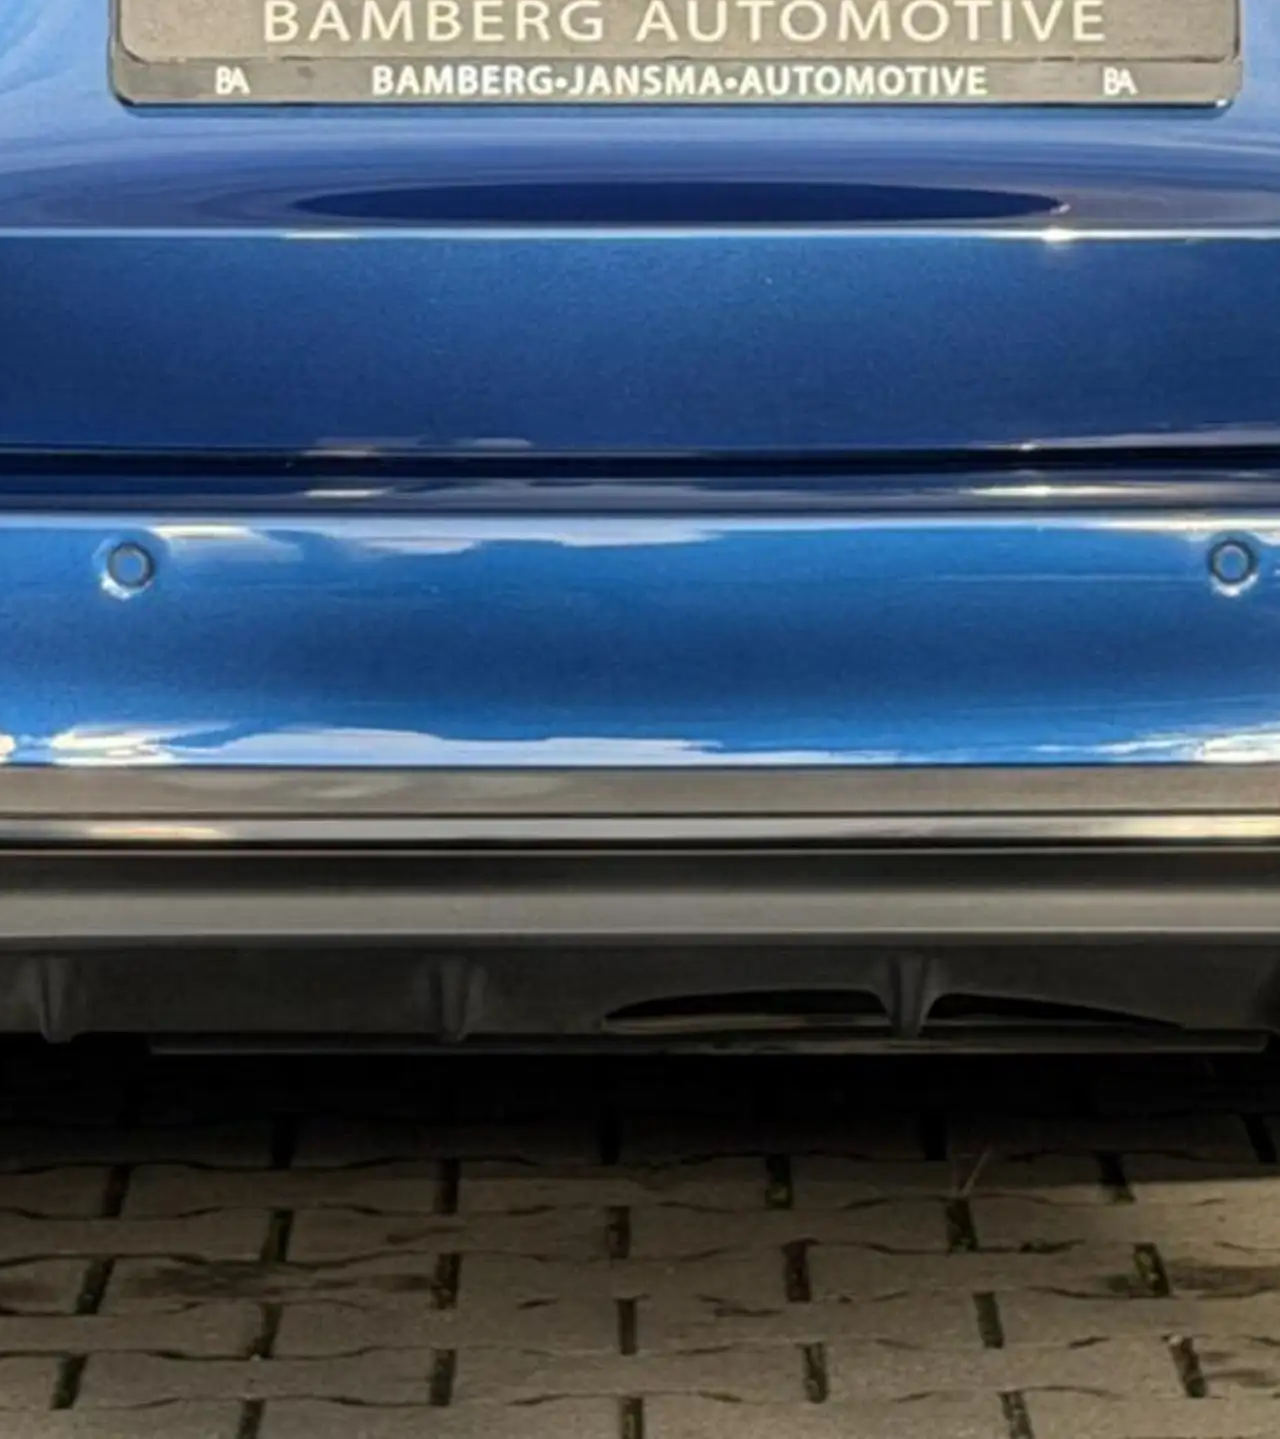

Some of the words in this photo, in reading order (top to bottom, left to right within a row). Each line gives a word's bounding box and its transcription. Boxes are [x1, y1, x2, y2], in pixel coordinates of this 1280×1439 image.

[263, 0, 604, 42] BAMBERG
[215, 65, 251, 96] BA
[1103, 66, 1139, 96] BA
